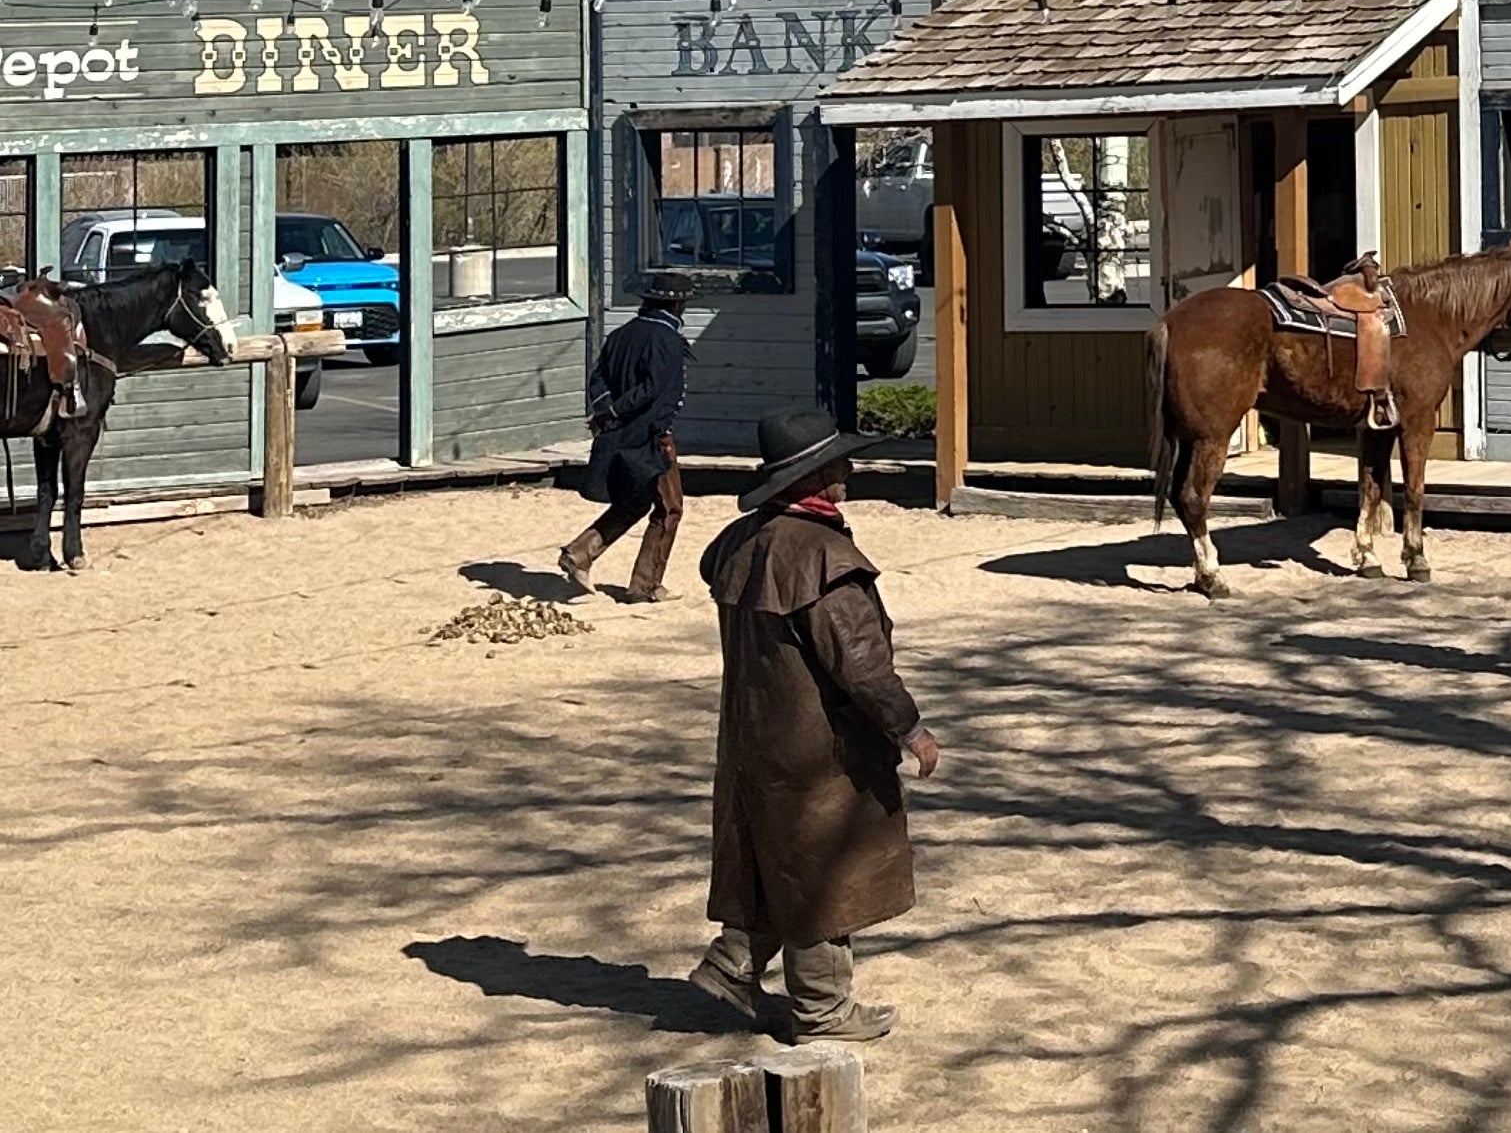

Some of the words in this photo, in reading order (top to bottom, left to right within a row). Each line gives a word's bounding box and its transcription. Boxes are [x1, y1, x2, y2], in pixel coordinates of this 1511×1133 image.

[0, 38, 140, 100] epot
[193, 13, 490, 95] DINER
[670, 8, 889, 76] BANK
